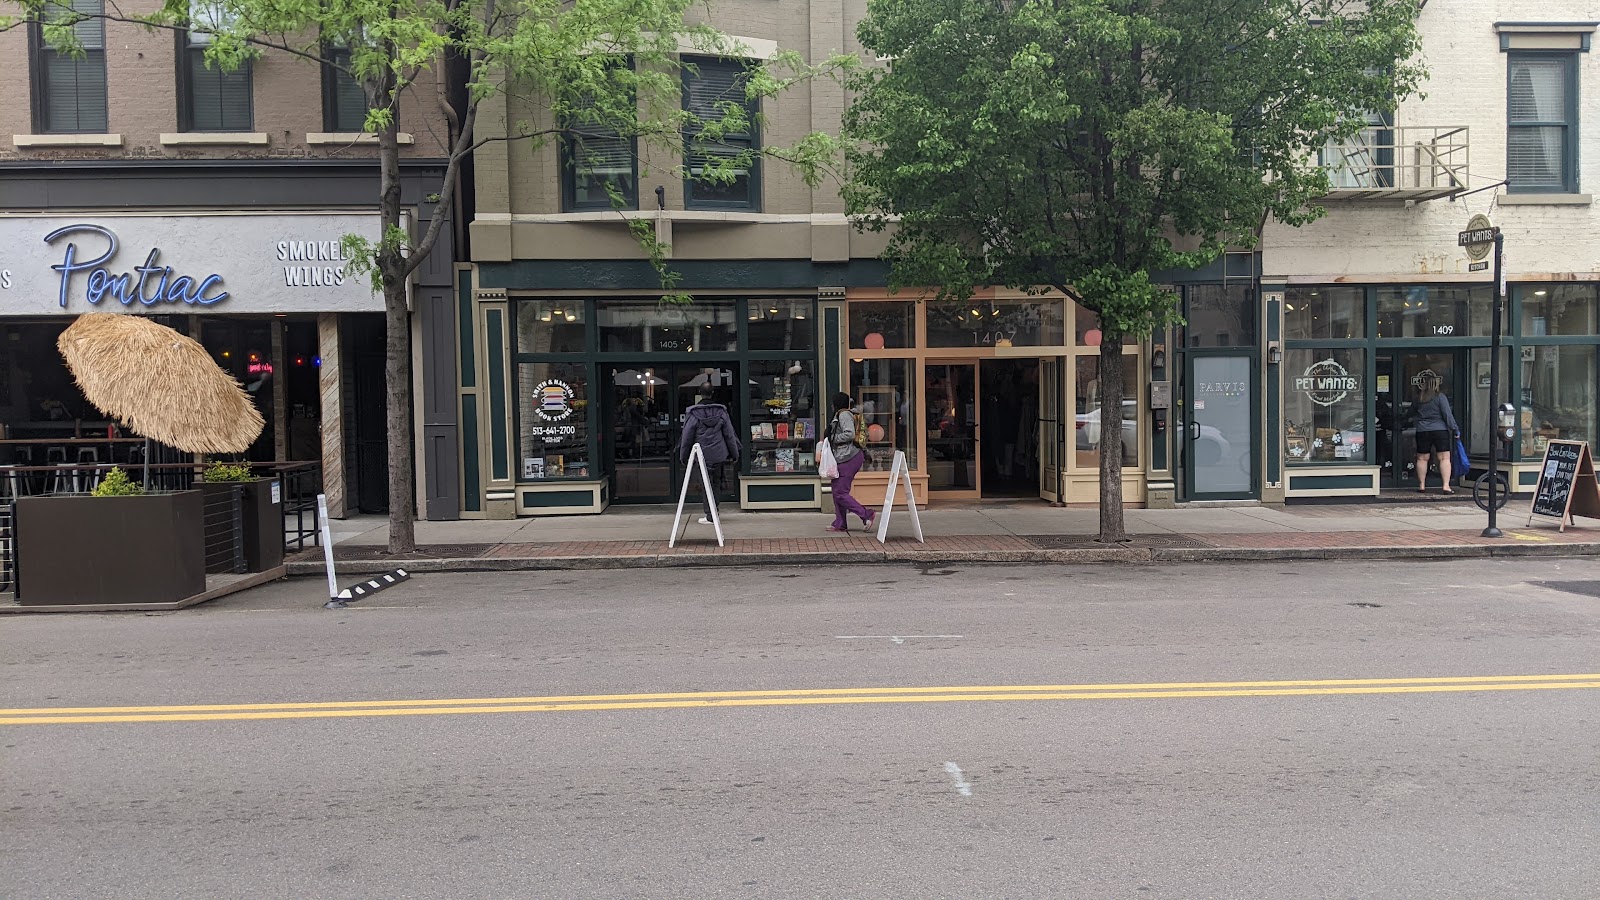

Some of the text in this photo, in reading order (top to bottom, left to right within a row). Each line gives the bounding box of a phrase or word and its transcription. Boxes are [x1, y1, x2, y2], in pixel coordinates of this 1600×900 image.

[1460, 233, 1470, 244] PET
[44, 223, 230, 308] Pontiac
[284, 266, 344, 286] WINGS
[1433, 325, 1453, 335] 1409
[973, 331, 1016, 344] 1407
[532, 381, 547, 398] SMITH
[554, 379, 575, 398] HANNON
[1200, 382, 1245, 391] PARVIS
[1295, 378, 1314, 389] PET
[535, 408, 573, 421] BOOK STORE
[532, 426, 575, 435] 513-641-2700
